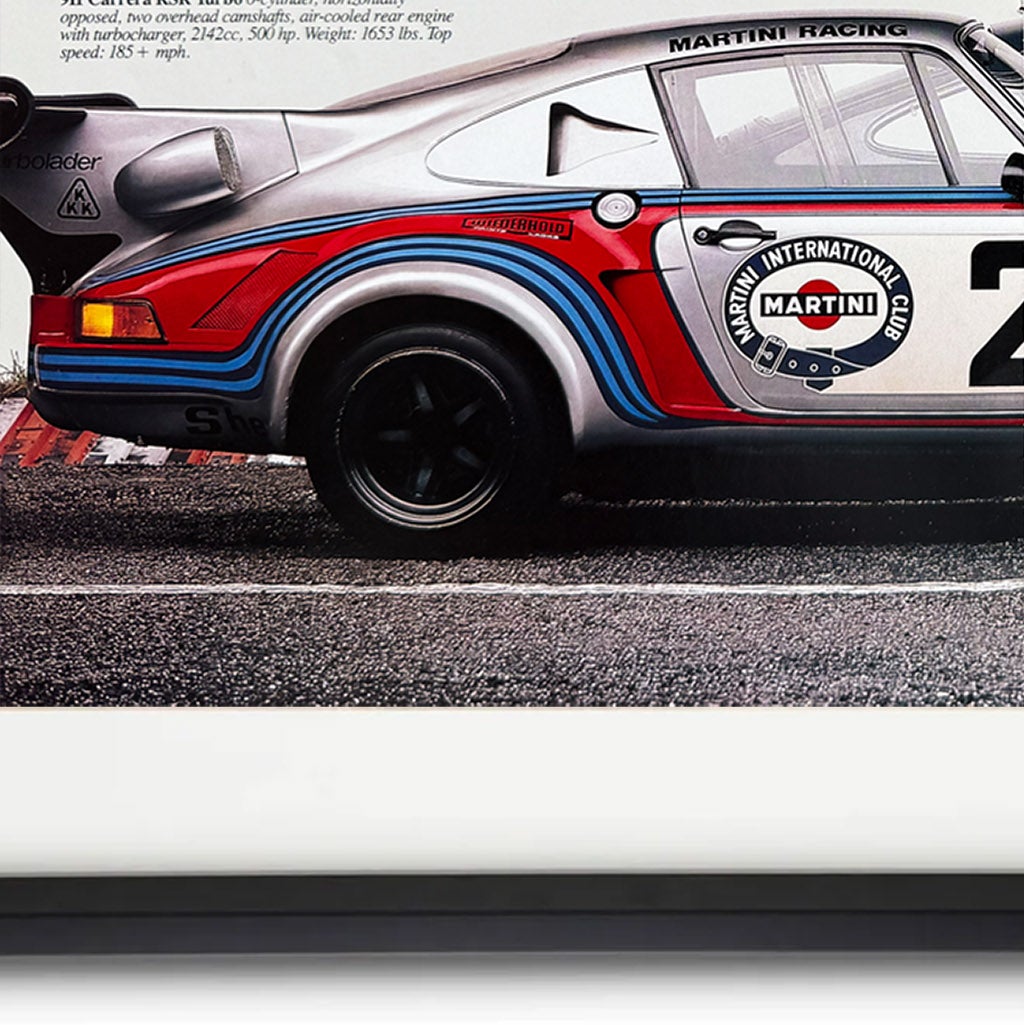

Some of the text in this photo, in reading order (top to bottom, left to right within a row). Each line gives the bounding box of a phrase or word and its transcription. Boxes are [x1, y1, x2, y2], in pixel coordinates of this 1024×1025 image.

[60, 8, 454, 26] opposed, two overhead camshafts, air-cooled rear engine
[60, 26, 452, 45] with turbocharger, 2142cc, 500 hp. Weight: 1653 lbs. Top
[669, 23, 908, 53] MARTINI RACING
[60, 44, 105, 62] speed:
[155, 44, 190, 62] mph.
[729, 239, 909, 345] MARTINI INTERNATIONAL CLUB
[763, 295, 875, 315] MARTINI
